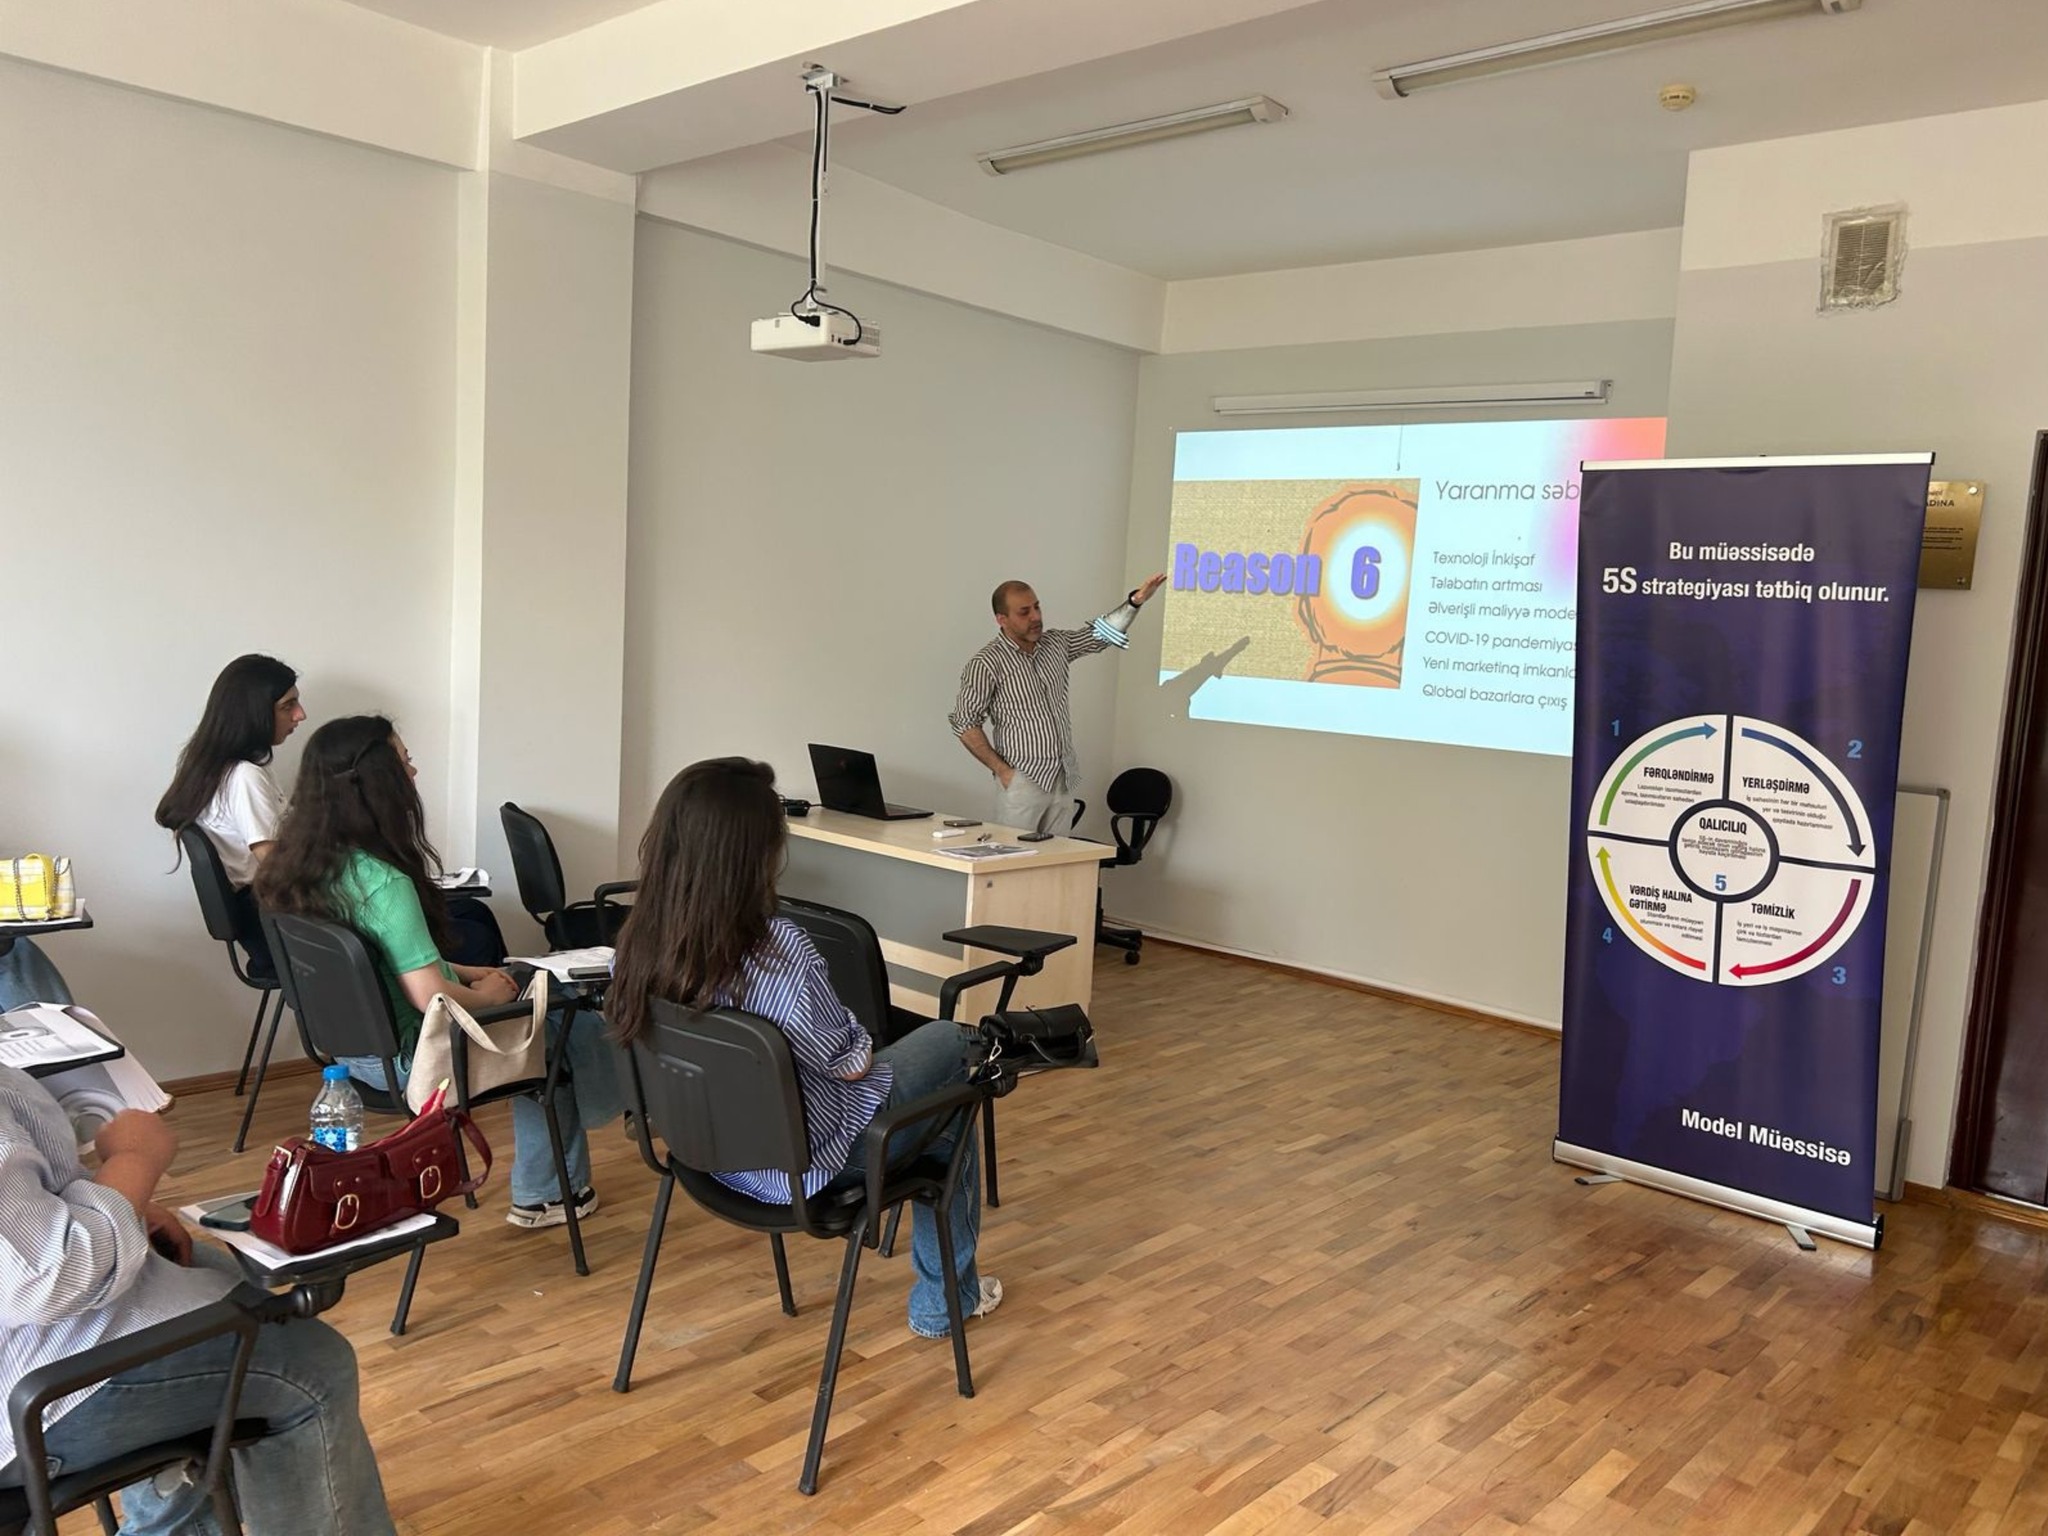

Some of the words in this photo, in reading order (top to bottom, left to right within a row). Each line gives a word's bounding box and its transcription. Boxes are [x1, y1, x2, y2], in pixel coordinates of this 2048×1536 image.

[1436, 480, 1535, 500] Yaranma
[1541, 480, 1581, 500] səb
[1433, 551, 1488, 567] Texnoloji
[1492, 550, 1535, 569] İnkişaf
[1669, 542, 1693, 560] Bu
[1699, 542, 1815, 562] müəssisədə
[1173, 543, 1322, 597] Reason
[1351, 546, 1382, 600] 6
[1431, 576, 1488, 591] Tələbatın
[1492, 579, 1543, 592] artması
[1602, 567, 1637, 594] 5S
[1641, 577, 1749, 600] strategiyası
[1755, 580, 1812, 603] tətbiq
[1818, 582, 1889, 602] olunur.
[1428, 601, 1476, 618] Əlverişli
[1479, 604, 1530, 620] maliyyə
[1425, 630, 1489, 646] COVID-19
[1423, 656, 1449, 670] Yeni
[1452, 660, 1520, 677] marketinq
[1422, 684, 1466, 699] Qlobal
[1469, 688, 1534, 705] bazarlara
[1538, 695, 1568, 711] çıxış
[1611, 720, 1621, 736] 1
[1847, 740, 1862, 758] 2
[1643, 766, 1714, 784] FƏRQLƏNDİRMƏ
[1742, 776, 1810, 794] YERLƏŞDİRMƏ
[1699, 817, 1747, 835] QALICILIQ
[1714, 874, 1727, 891] 5
[1629, 885, 1660, 900] VƏRDİŞ
[1662, 889, 1693, 903] HALINA
[1629, 898, 1667, 912] GƏTİRMƏ
[1751, 903, 1795, 919] TƏMİZLİK
[1602, 927, 1612, 943] 4
[1832, 967, 1846, 984] 3
[1681, 1108, 1743, 1140] Model
[1749, 1124, 1851, 1166] Müəssisə
